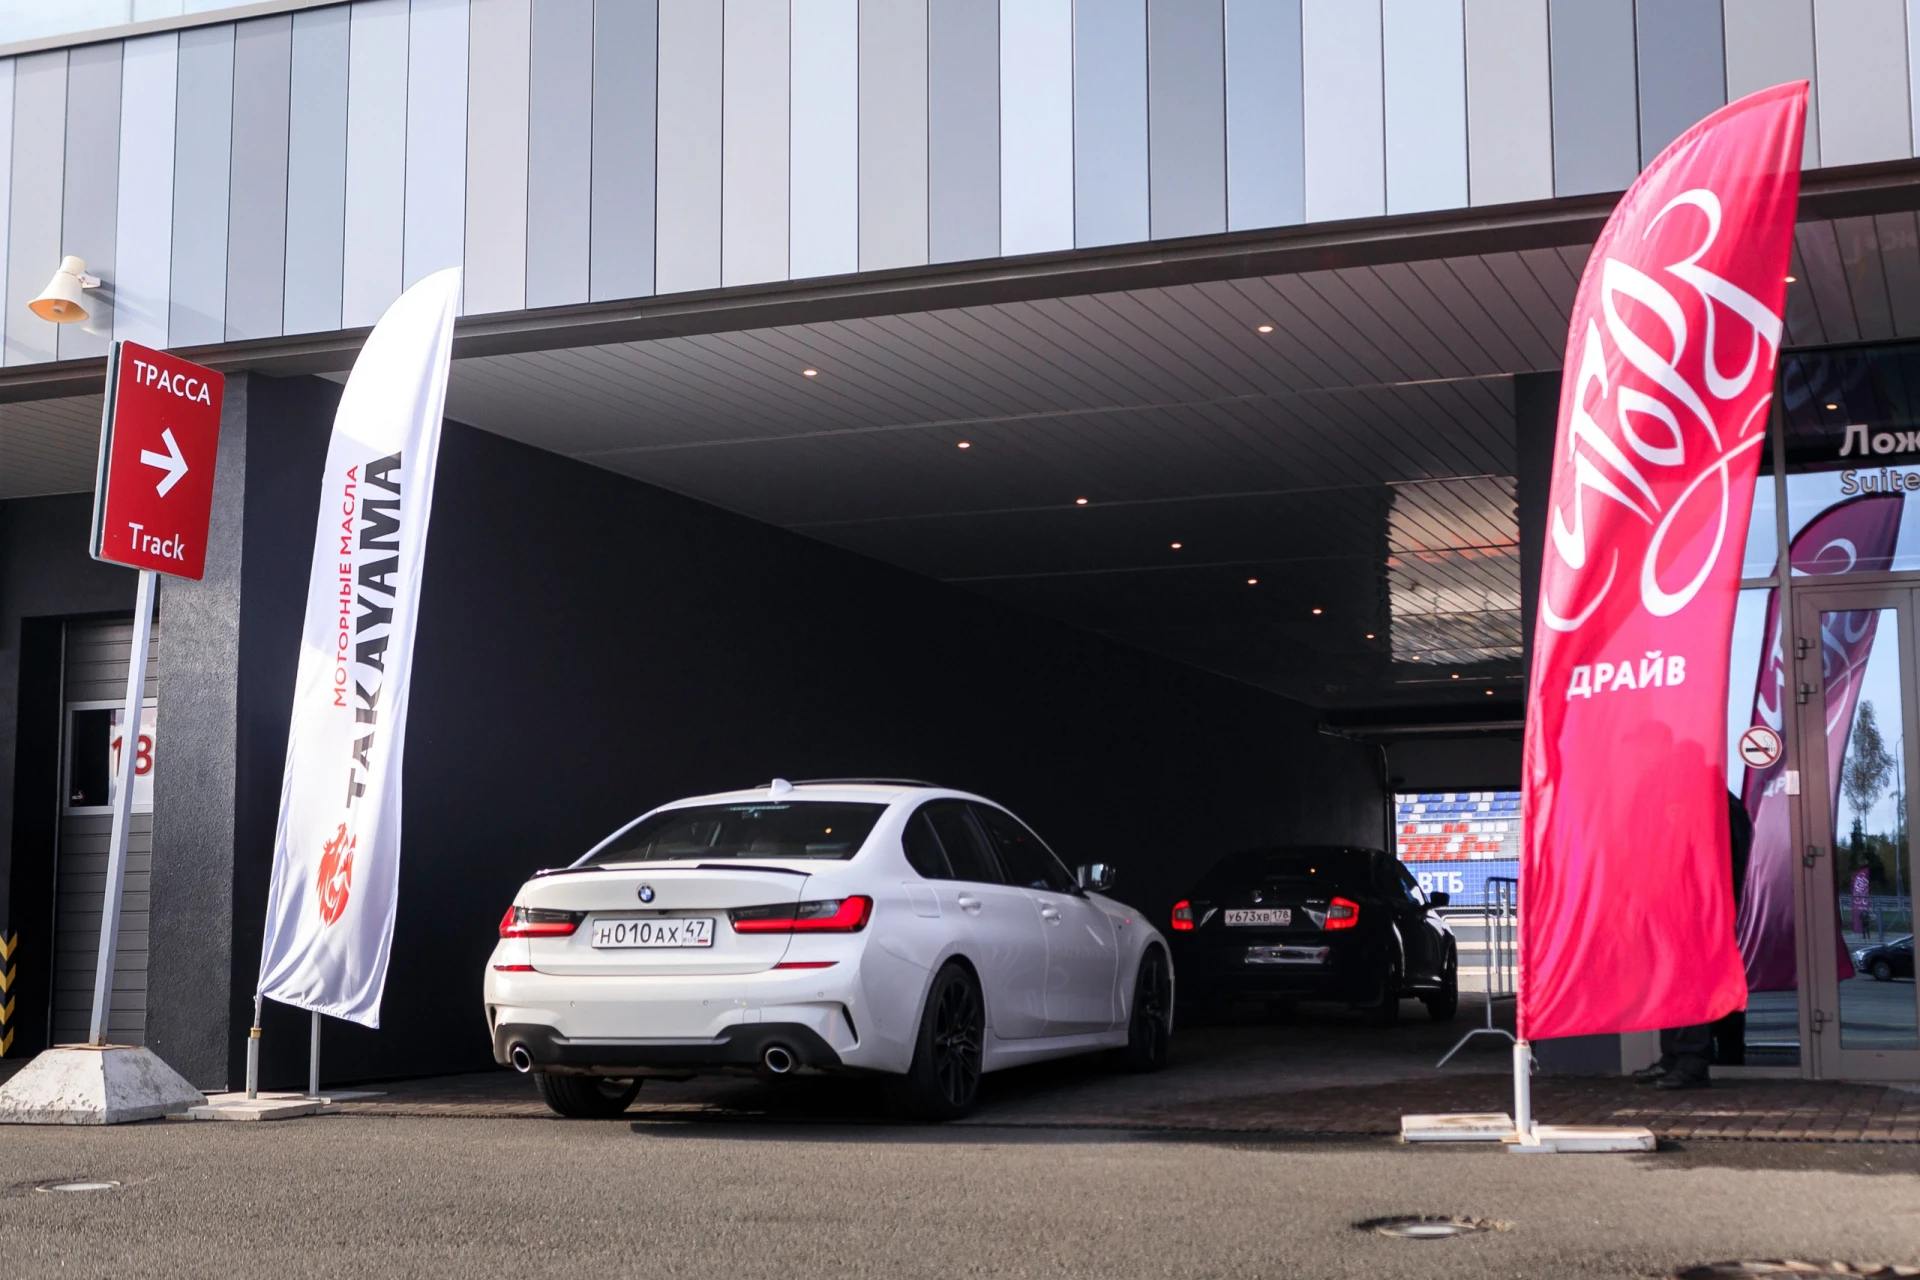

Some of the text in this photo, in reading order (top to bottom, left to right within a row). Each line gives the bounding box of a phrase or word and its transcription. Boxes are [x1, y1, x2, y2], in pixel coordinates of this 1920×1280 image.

[133, 359, 211, 406] ТРАССА
[128, 521, 186, 561] Track
[333, 464, 359, 707] МОТОРНЫЕ МАСЛА
[346, 450, 402, 809] TAKAYAMA
[1566, 650, 1687, 700] ДРАЙВ
[1417, 871, 1464, 894] ВТБ
[599, 921, 705, 944] Н010АХ 47
